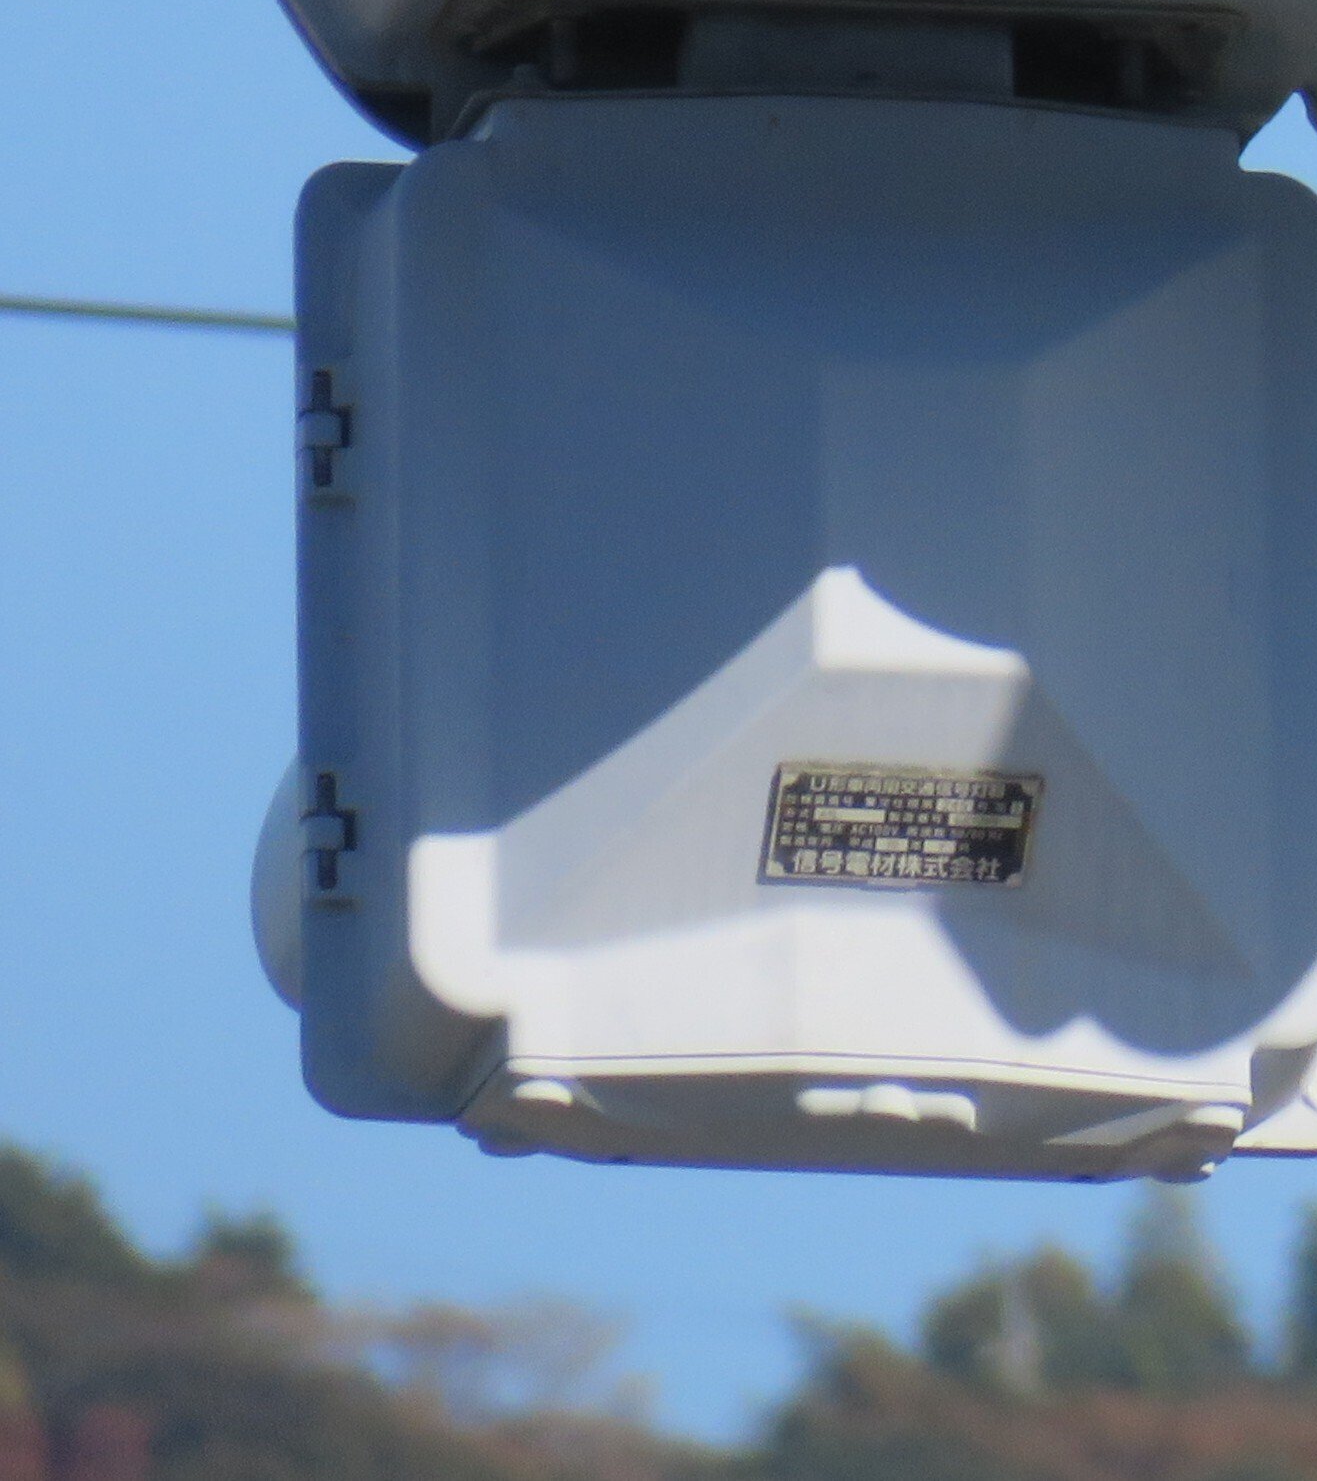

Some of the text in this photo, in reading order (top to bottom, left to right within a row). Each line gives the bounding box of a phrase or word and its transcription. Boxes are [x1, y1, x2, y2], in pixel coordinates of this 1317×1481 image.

[793, 849, 1002, 881] 信号電材株式会社
